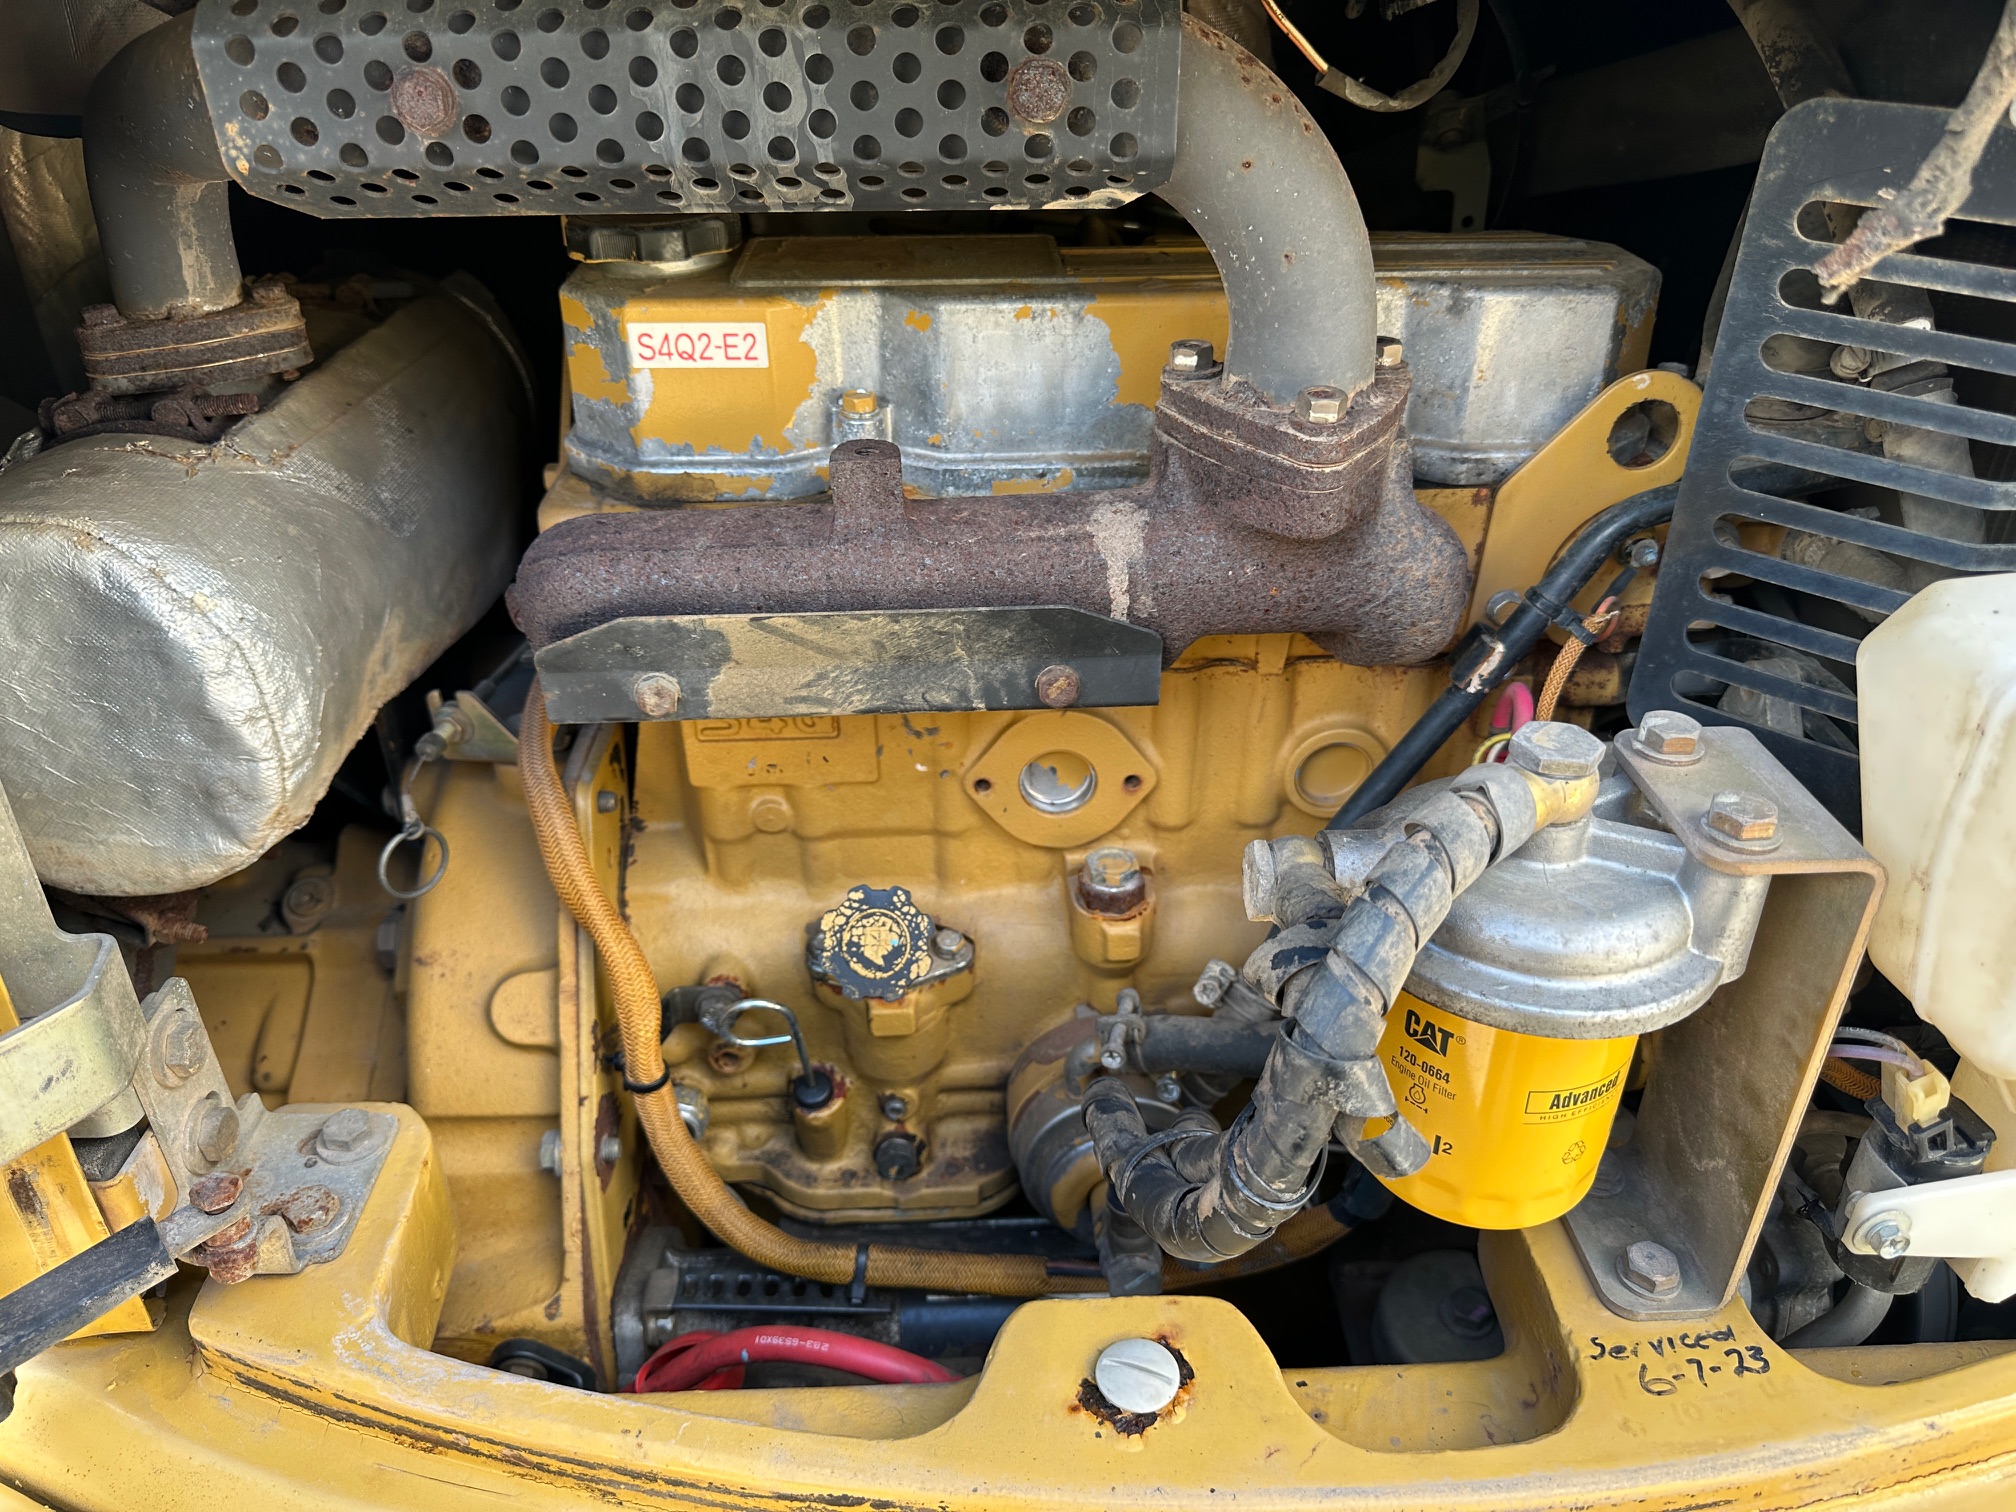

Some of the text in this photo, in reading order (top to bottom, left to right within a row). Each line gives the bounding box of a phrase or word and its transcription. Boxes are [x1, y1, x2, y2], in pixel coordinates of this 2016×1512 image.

[638, 333, 758, 362] S4Q2-E2
[1404, 1009, 1455, 1058] CAT
[1391, 1055, 1456, 1100] Engine Oil Filter
[1399, 1045, 1450, 1084] 120-0664
[1549, 1070, 1620, 1110] Advanced
[1539, 1113, 1567, 1121] HIGH
[1638, 1345, 1770, 1396] 6-7-23
